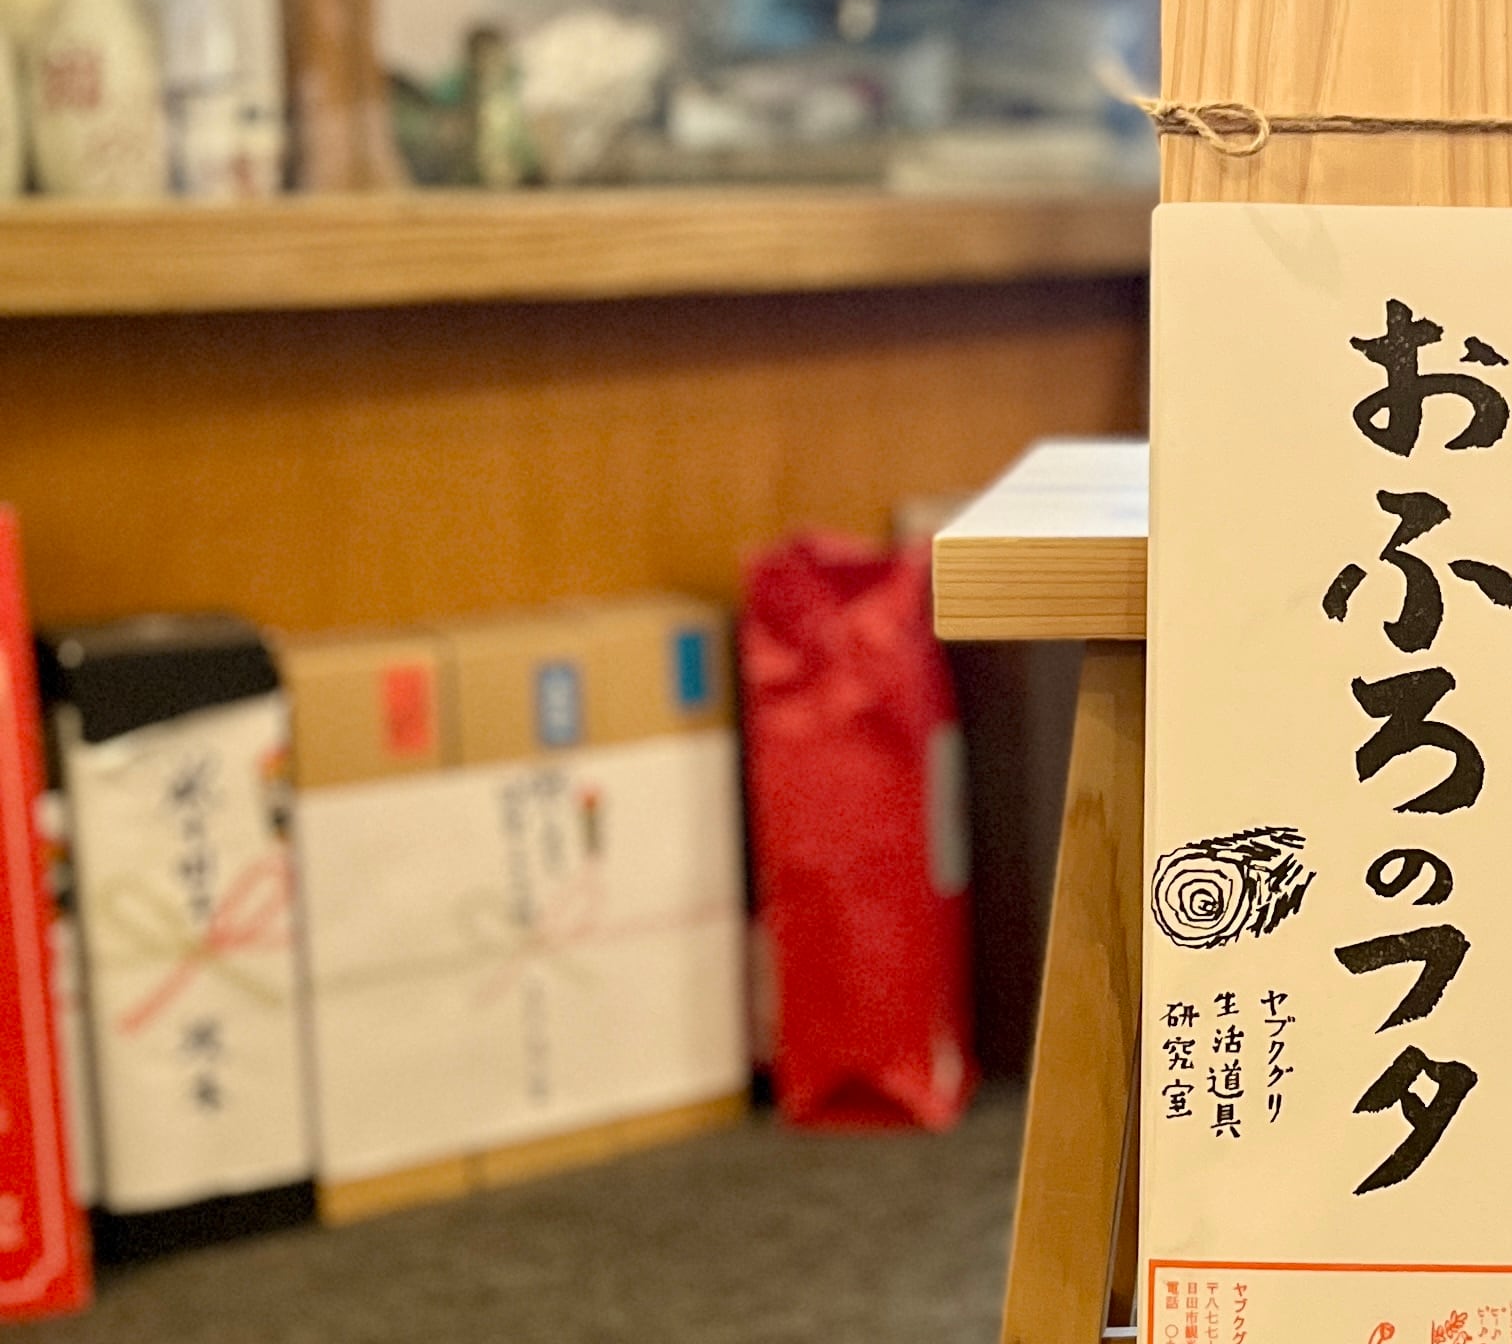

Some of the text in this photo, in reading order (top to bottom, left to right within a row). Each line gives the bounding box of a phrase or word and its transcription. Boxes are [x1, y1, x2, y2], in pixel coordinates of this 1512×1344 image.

[1159, 1002, 1201, 1119] 研究室
[1206, 991, 1245, 1138] 生活道具
[1260, 990, 1296, 1123] ヤブクグリ
